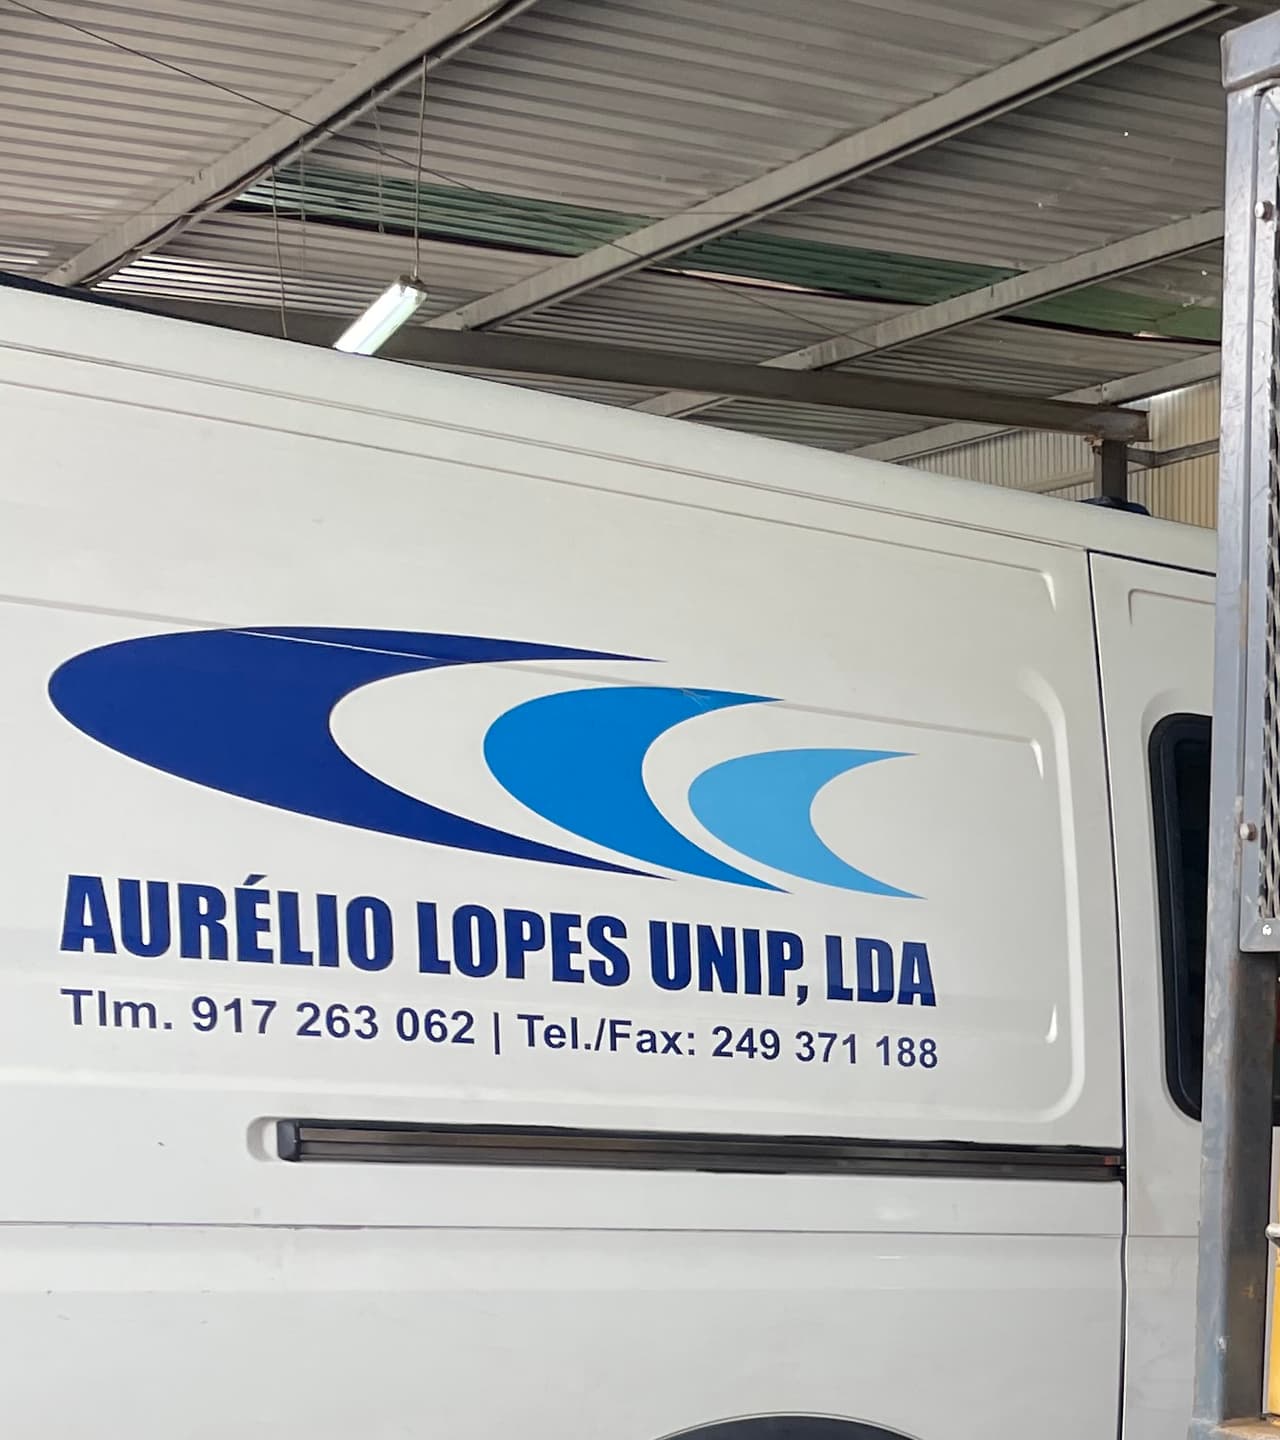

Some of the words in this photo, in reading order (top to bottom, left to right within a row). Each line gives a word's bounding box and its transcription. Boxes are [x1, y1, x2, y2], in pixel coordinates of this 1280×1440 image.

[60, 874, 394, 972] AURÉLIO
[417, 901, 631, 987] LOPES
[648, 919, 809, 1006] UNIP,
[825, 934, 937, 1008] LDA
[60, 988, 172, 1030] Tlm.
[191, 996, 277, 1034] 917
[296, 1002, 379, 1040] 263
[396, 1007, 475, 1045] 062
[516, 1013, 696, 1056] Tel./Fax:
[711, 1025, 781, 1061] 249
[795, 1030, 857, 1065] 371
[876, 1035, 938, 1069] 188
